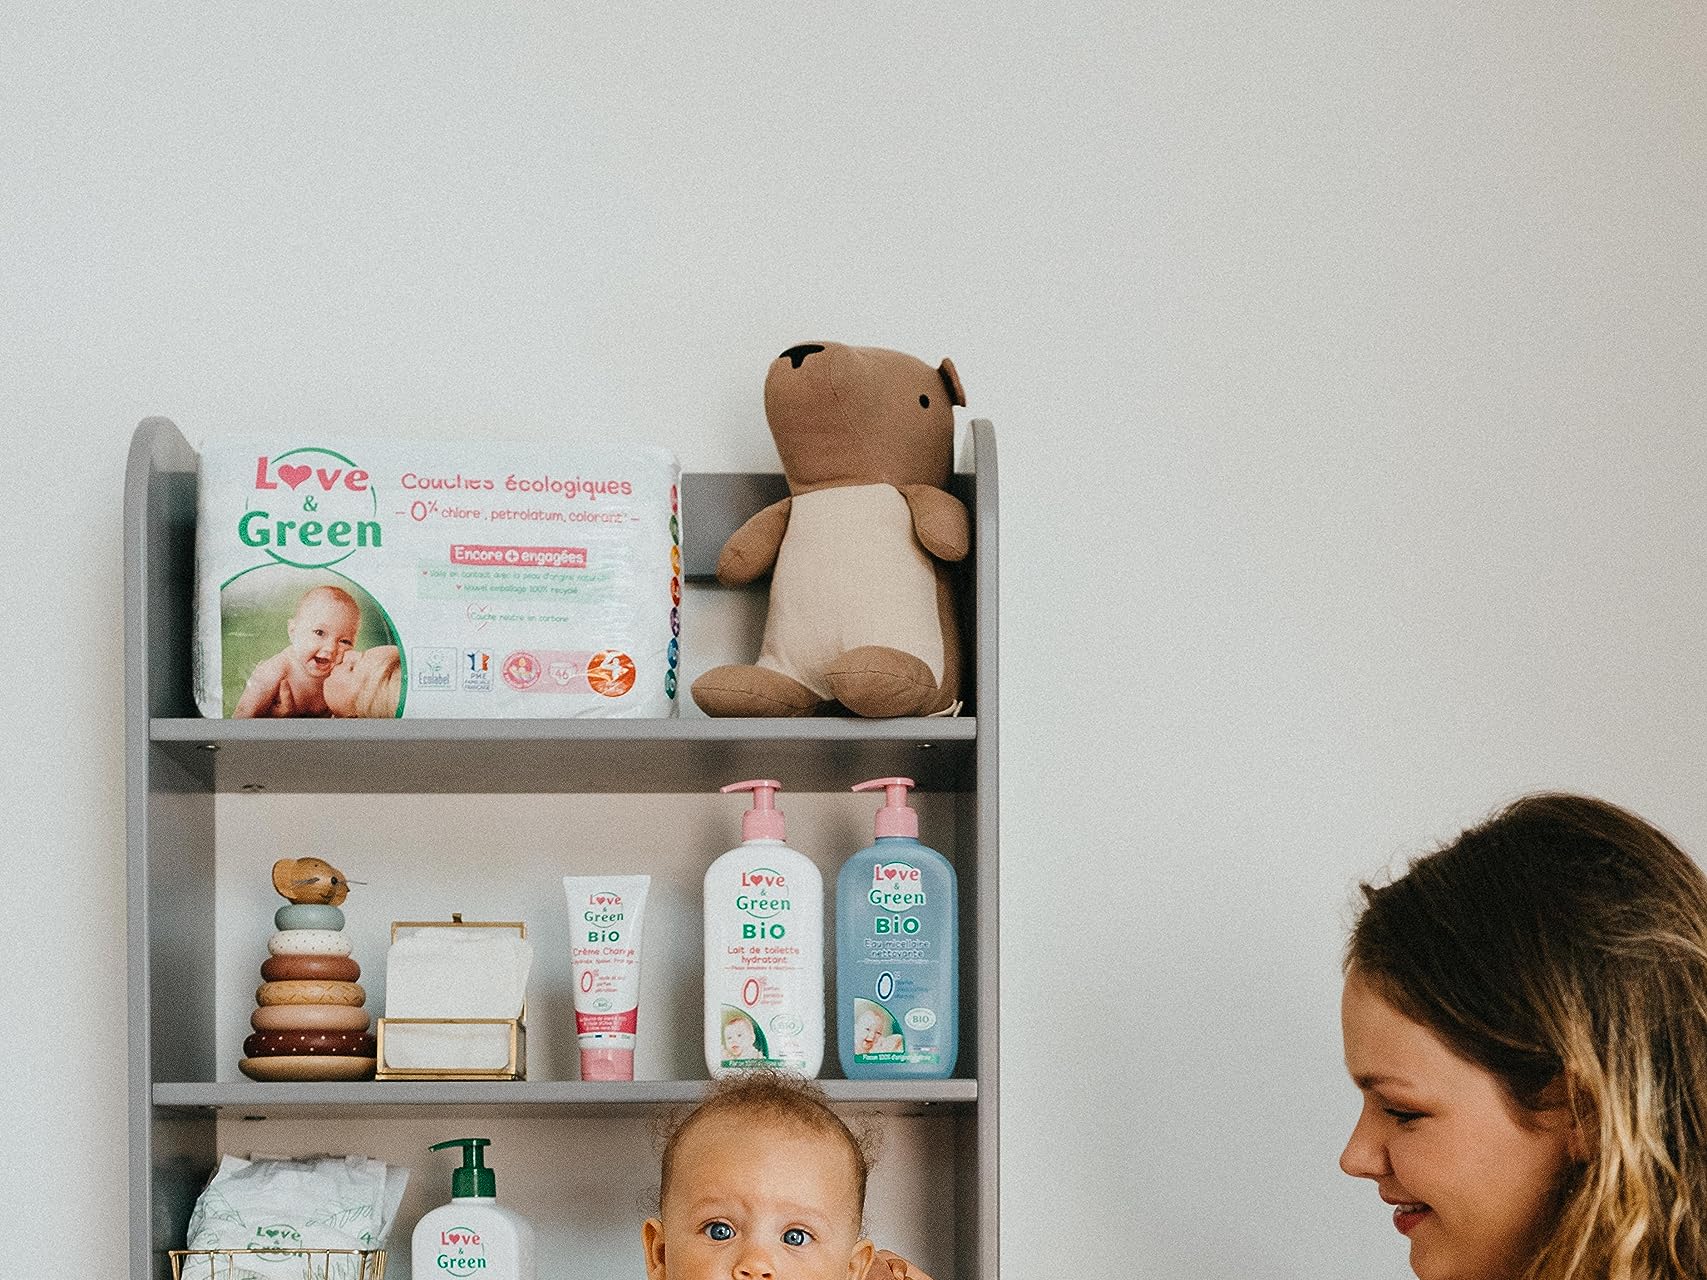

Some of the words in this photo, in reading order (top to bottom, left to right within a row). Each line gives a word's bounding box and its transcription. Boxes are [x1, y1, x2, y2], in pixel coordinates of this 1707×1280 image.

[505, 474, 632, 500] écologiques
[303, 495, 318, 512] &
[238, 511, 382, 547] Green
[454, 546, 502, 560] Encore
[522, 550, 584, 566] engagées
[736, 895, 790, 911] Green
[870, 889, 924, 905] Green
[584, 911, 624, 922] Green
[727, 945, 745, 955] Lait
[749, 946, 760, 955] de
[741, 955, 788, 966] hydratant
[912, 1015, 930, 1024] BIO
[360, 1231, 373, 1245] 4
[437, 1254, 486, 1269] Green
